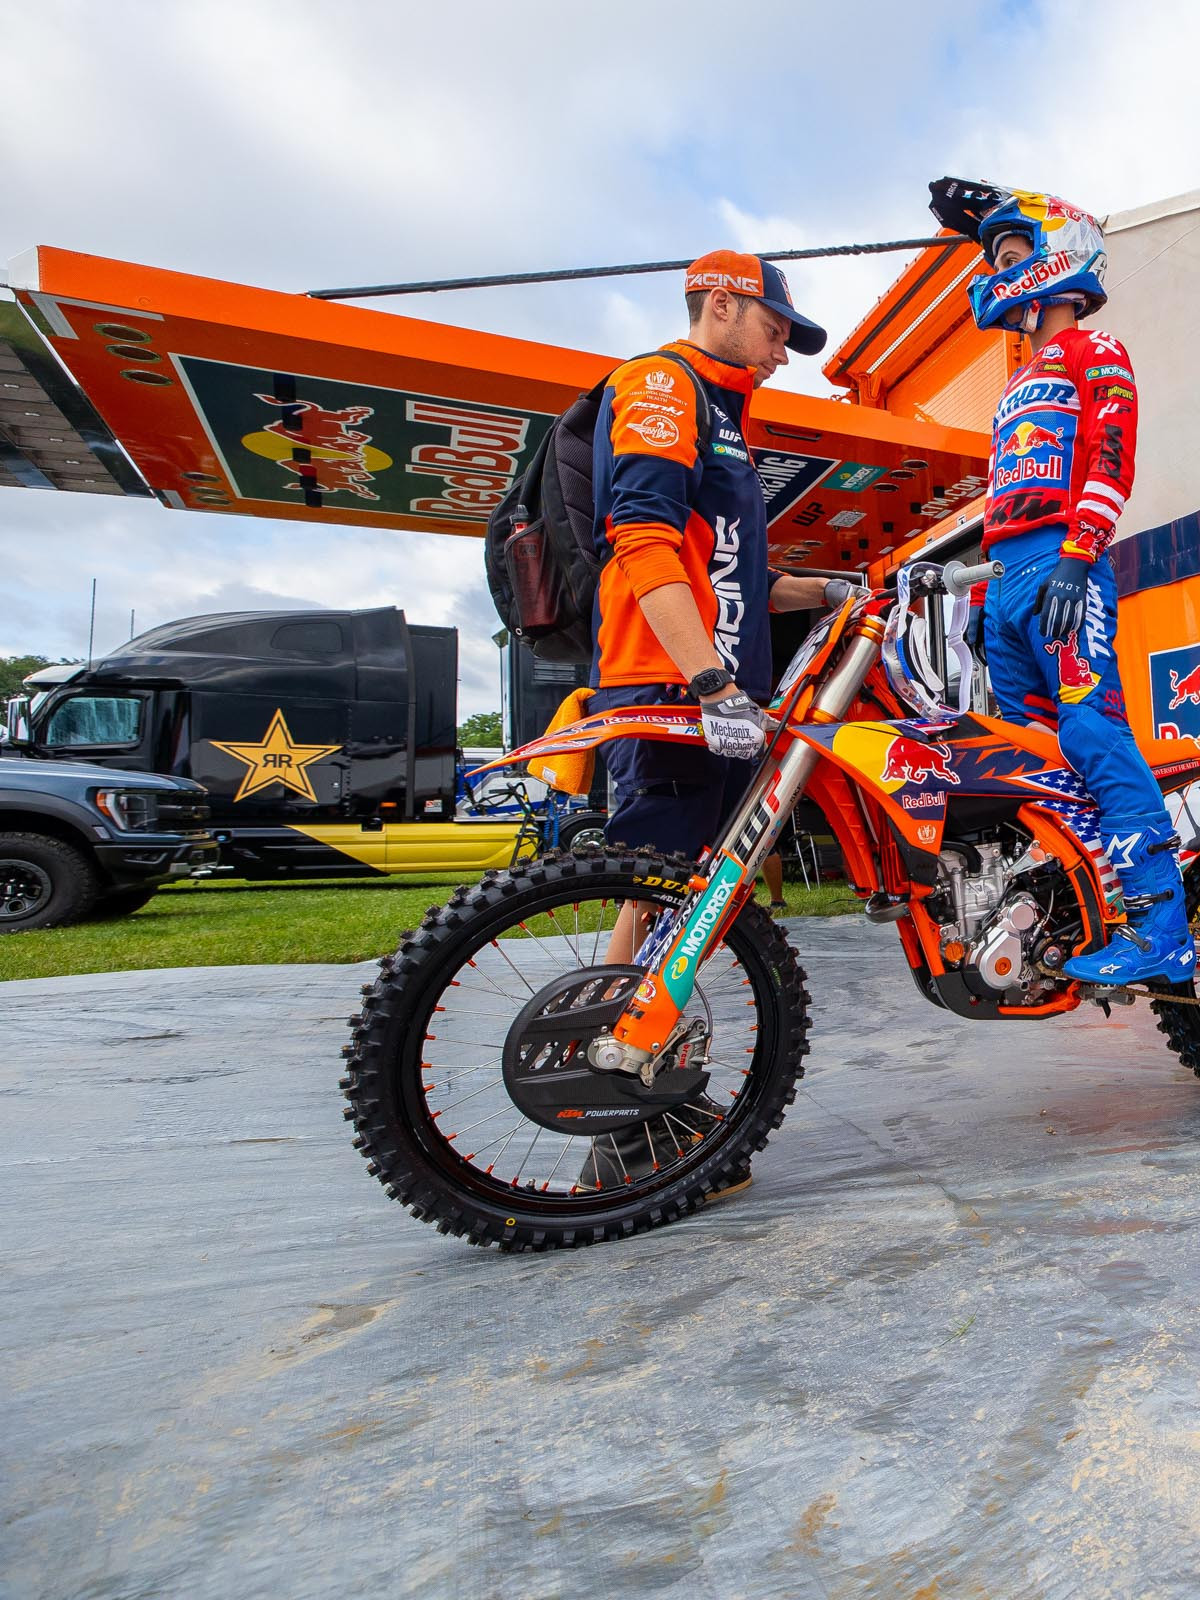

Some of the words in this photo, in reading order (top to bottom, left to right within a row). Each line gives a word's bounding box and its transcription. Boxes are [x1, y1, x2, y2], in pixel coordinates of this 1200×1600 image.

[992, 269, 1034, 298] Red
[1031, 250, 1071, 284] Bull
[996, 457, 1024, 490] Red
[1022, 455, 1063, 480] Bull
[986, 491, 1061, 526] KTM
[710, 516, 745, 681] ACING
[1051, 580, 1080, 593] THOR
[710, 720, 751, 739] Mechanix
[1152, 765, 1179, 776] NIVERSITY
[902, 793, 925, 809] Red
[924, 791, 946, 806] Bull
[681, 878, 738, 957] MOTOREX
[557, 1109, 584, 1119] KTM
[585, 1108, 640, 1118] POWERPARTS
